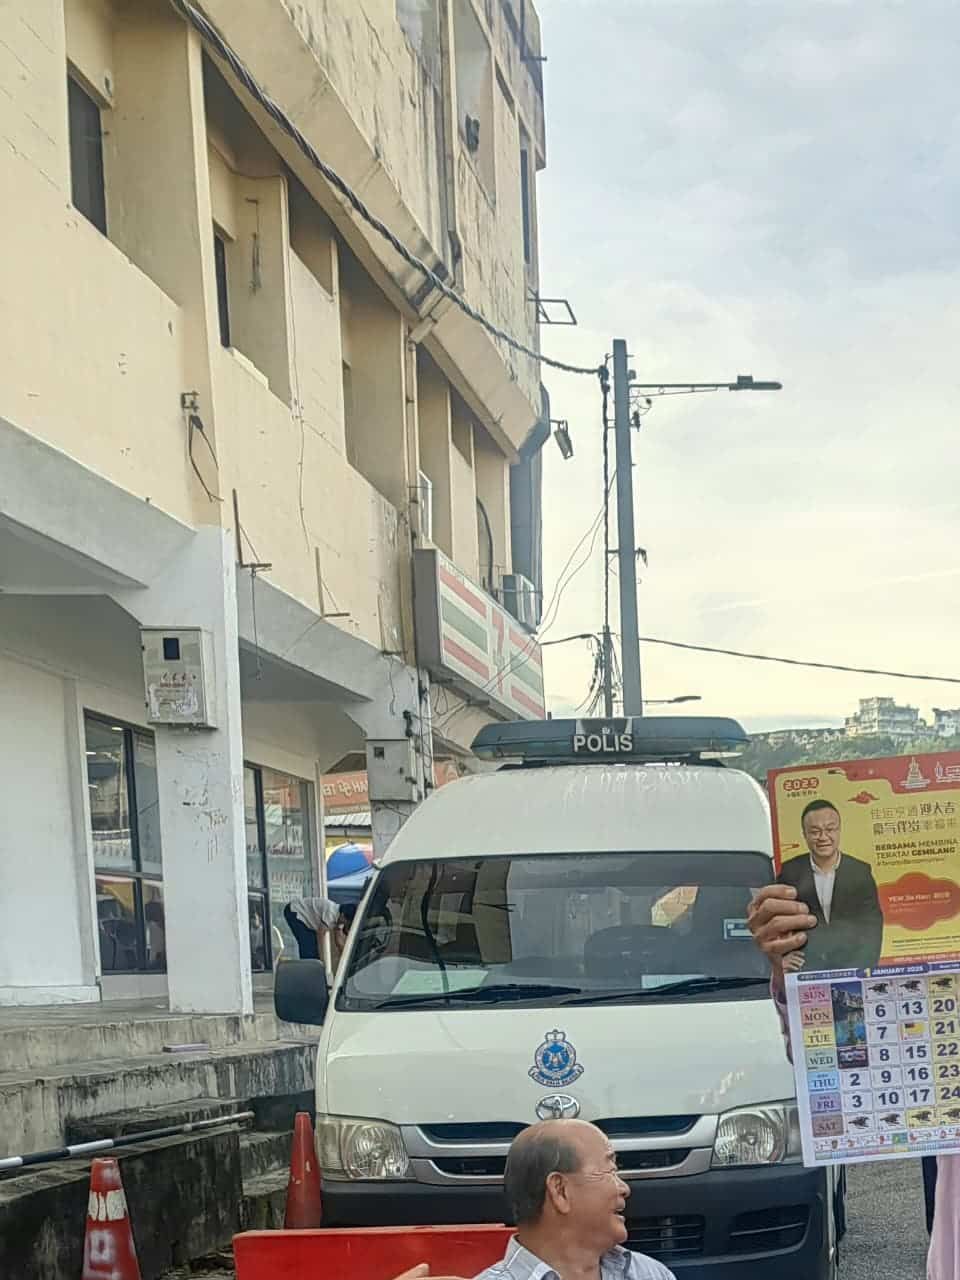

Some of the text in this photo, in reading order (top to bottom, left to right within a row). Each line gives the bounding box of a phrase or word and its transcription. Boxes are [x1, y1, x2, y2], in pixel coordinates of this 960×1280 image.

[573, 735, 633, 752] POLIS
[784, 777, 819, 791] 2025
[875, 842, 917, 851] BERSAMA
[872, 967, 905, 976] JANUARY
[804, 990, 825, 1000] SUN
[875, 1004, 886, 1017] 6
[902, 1001, 923, 1015] 13
[933, 999, 955, 1012] 20
[805, 1012, 830, 1021] MON
[877, 1026, 887, 1039] 7
[935, 1020, 955, 1034] 21
[808, 1033, 831, 1043] TUE
[880, 1048, 890, 1061] 8
[905, 1045, 927, 1059] 15
[937, 1042, 959, 1056] 22
[810, 1056, 834, 1065] WED
[881, 1070, 892, 1083] 9
[907, 1067, 929, 1081] 16
[938, 1064, 960, 1078] 23
[813, 1078, 836, 1088] THU
[849, 1073, 861, 1086] 2
[852, 1095, 863, 1108] 3
[879, 1091, 899, 1105] 10
[909, 1089, 930, 1102] 17
[816, 1099, 835, 1109] FRI
[818, 1120, 838, 1132] SAT
